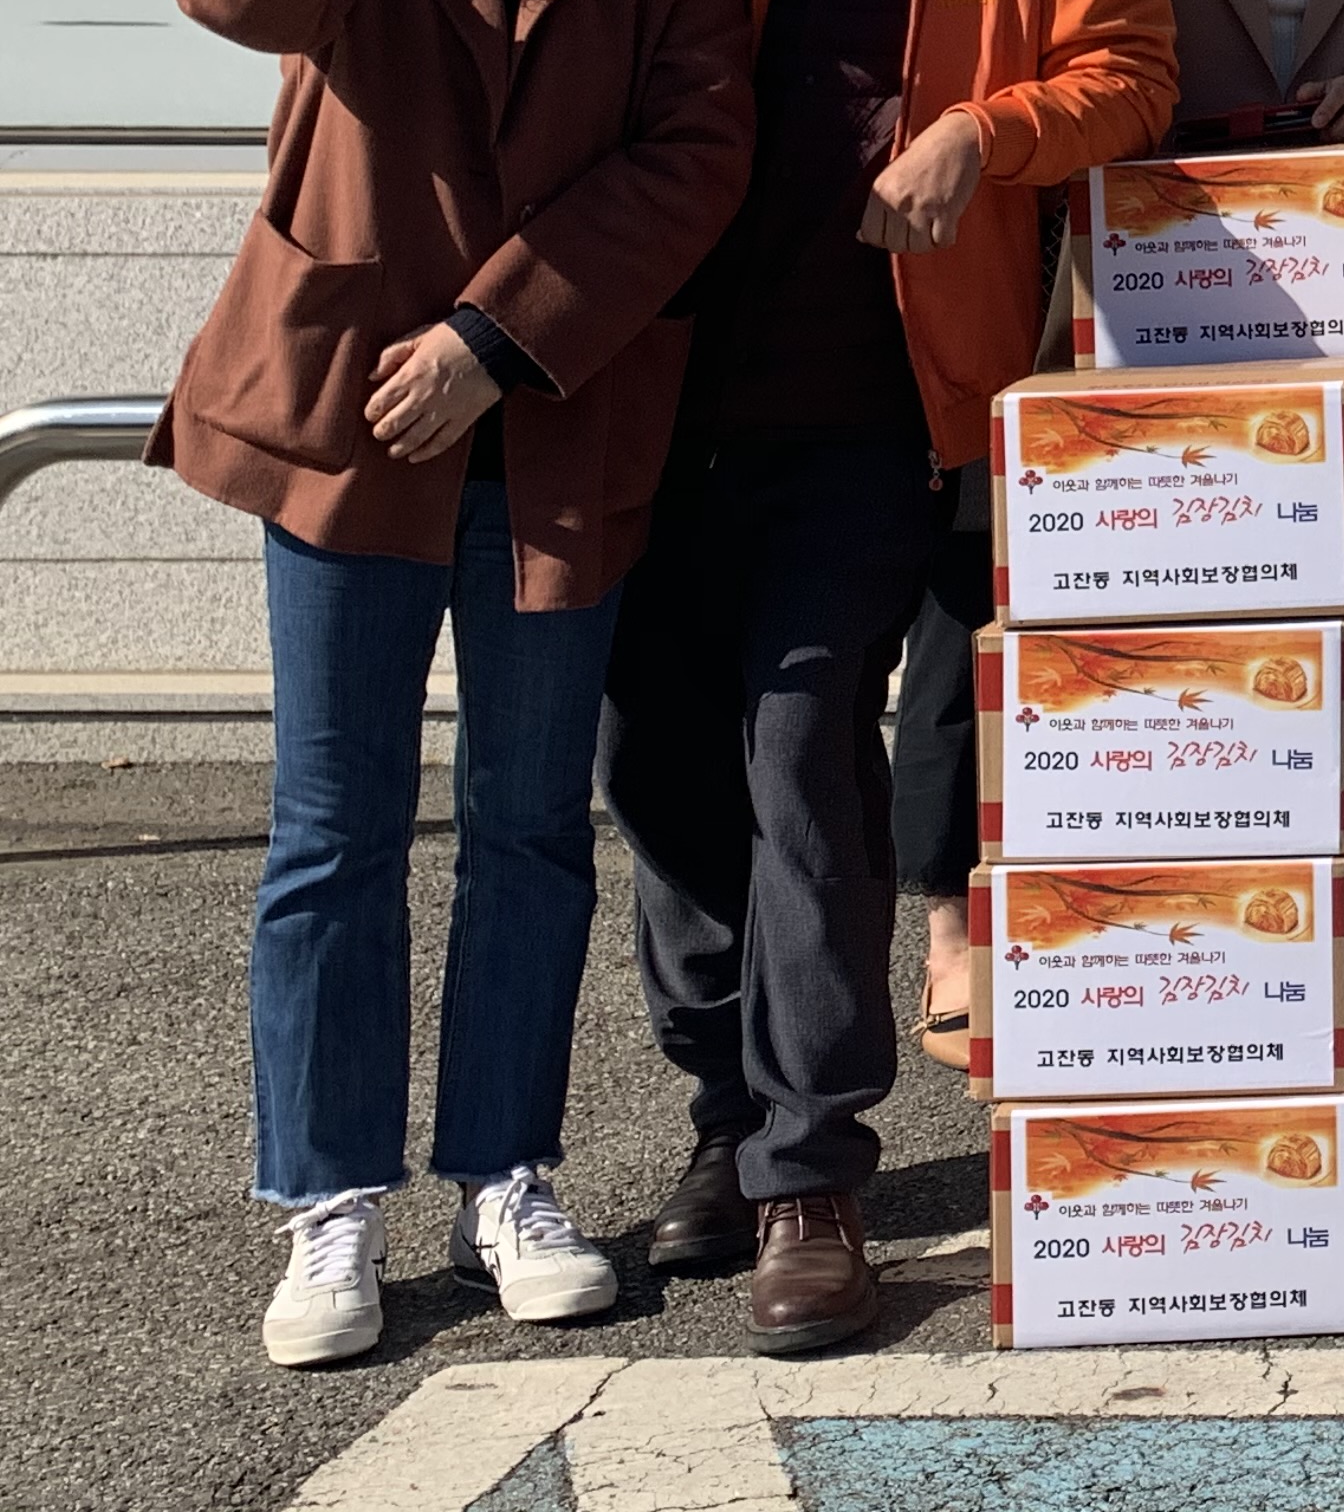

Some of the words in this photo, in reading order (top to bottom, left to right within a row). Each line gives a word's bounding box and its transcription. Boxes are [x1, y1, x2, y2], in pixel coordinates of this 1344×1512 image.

[1135, 241, 1169, 254] 이웃과
[1174, 240, 1218, 253] 함께하는
[1223, 238, 1257, 250] 따뜻한
[1263, 236, 1306, 248] 겨울나기
[1113, 272, 1163, 291] 2020
[1175, 268, 1232, 289] 사랑의
[1246, 256, 1329, 286] 김장김치
[1136, 327, 1188, 344] 고잔동
[1053, 479, 1089, 492] 이웃과
[1095, 477, 1142, 491] 함께하는
[1148, 475, 1185, 488] 따뜻한
[1191, 473, 1237, 486] 겨울나기
[1029, 512, 1083, 532] 2020
[1096, 508, 1157, 531] 사랑의
[1173, 495, 1263, 527] 김장김치
[1277, 502, 1318, 522] 나눔
[1054, 572, 1109, 590] 고잔동
[1123, 563, 1297, 587] 지역사회보장협의체
[1059, 1205, 1096, 1218] 이웃과
[1102, 1203, 1150, 1216] 함께하는
[1157, 1201, 1194, 1213] 따뜻한
[1200, 1198, 1247, 1211] 겨울나기
[1034, 1238, 1089, 1259] 2020
[1102, 1234, 1165, 1257] 사랑의
[1181, 1221, 1272, 1254] 김장김치
[1288, 1227, 1329, 1248] 나눔
[1058, 1299, 1115, 1317] 고잔동
[1129, 1290, 1307, 1315] 지역사회보장협의체
